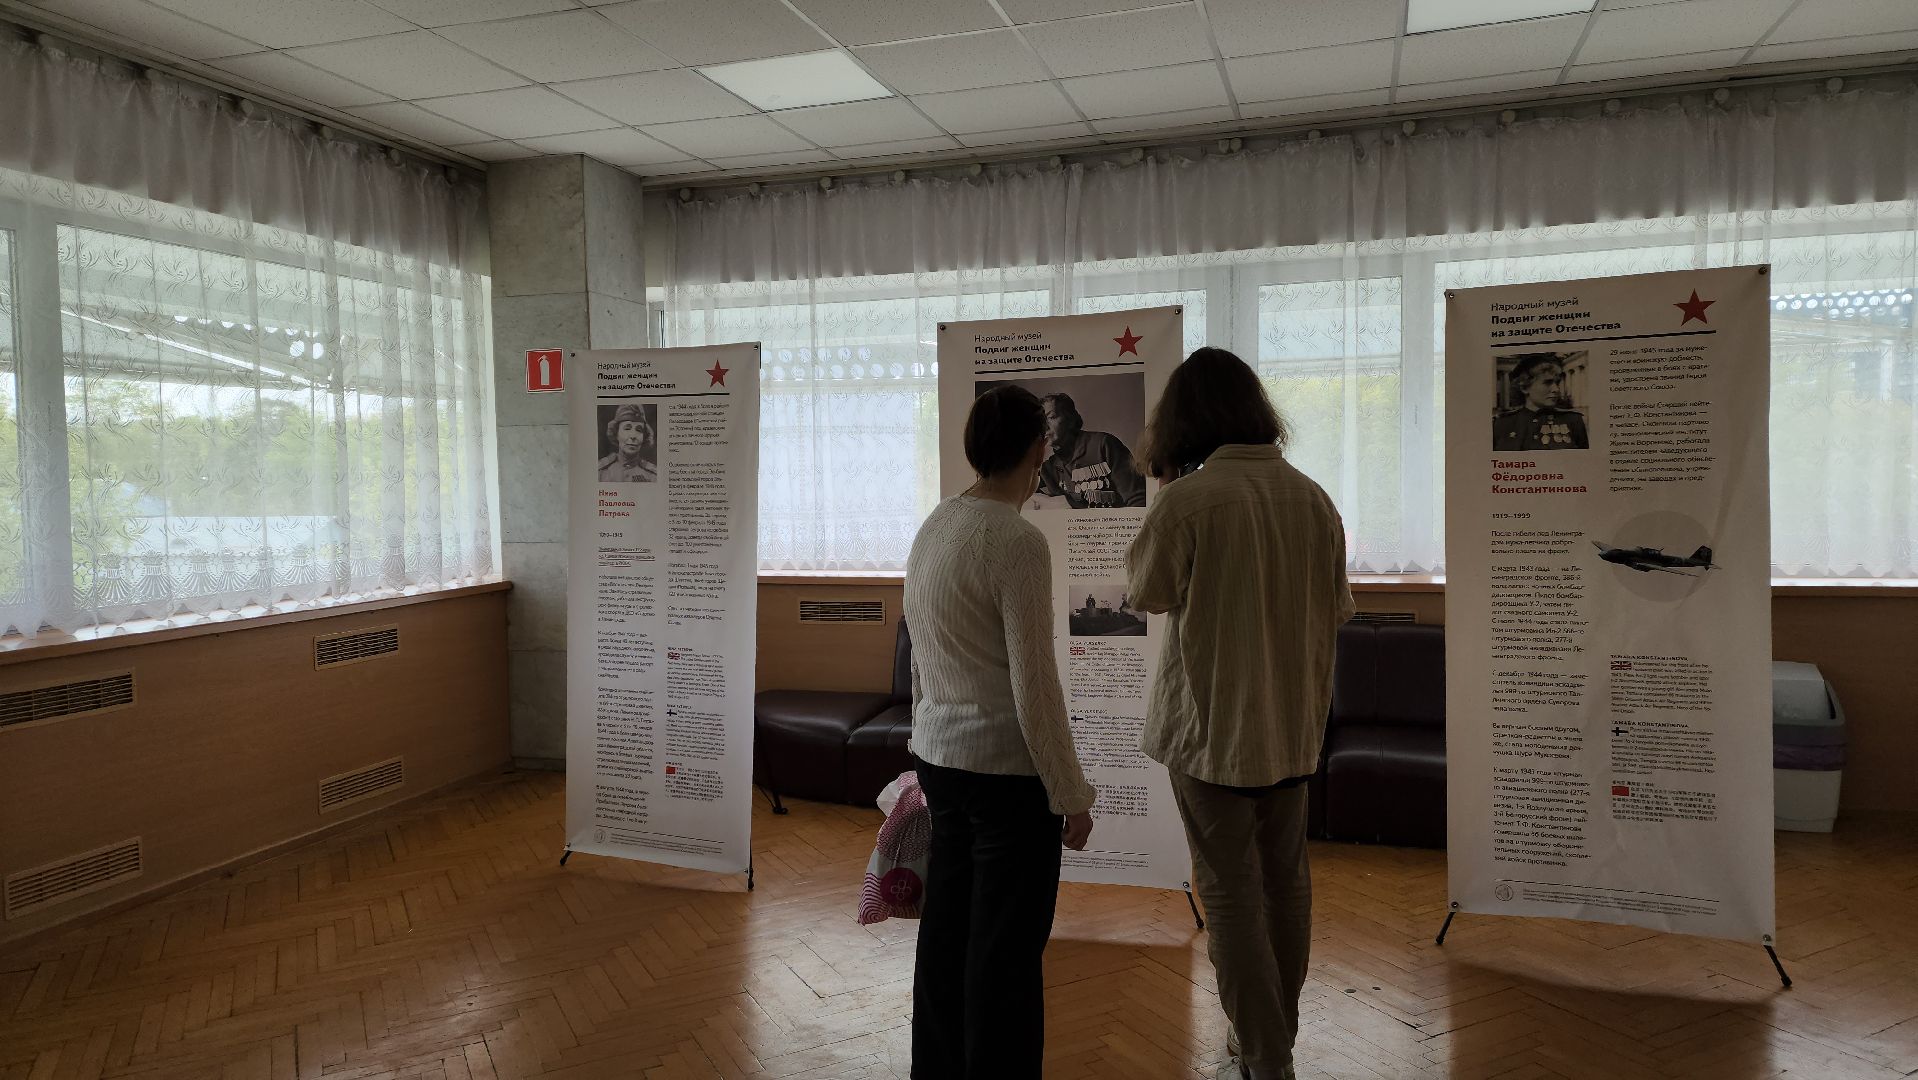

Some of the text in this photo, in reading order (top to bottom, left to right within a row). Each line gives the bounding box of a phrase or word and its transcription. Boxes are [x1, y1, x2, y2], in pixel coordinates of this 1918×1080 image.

[1492, 298, 1579, 312] Народный музей
[1492, 311, 1590, 325] Подвиг женщин
[1492, 321, 1621, 338] на защите Отечества
[975, 332, 1042, 343] Народный музей
[975, 343, 1051, 354] Подвиг женщин
[632, 361, 650, 369] музей
[988, 356, 1022, 365] защите
[1025, 354, 1074, 363] Отечества
[1492, 460, 1536, 469] Тамара
[1492, 472, 1563, 482] Фёдоровна
[1492, 485, 1587, 494] Константинова
[599, 510, 629, 518] Петрова
